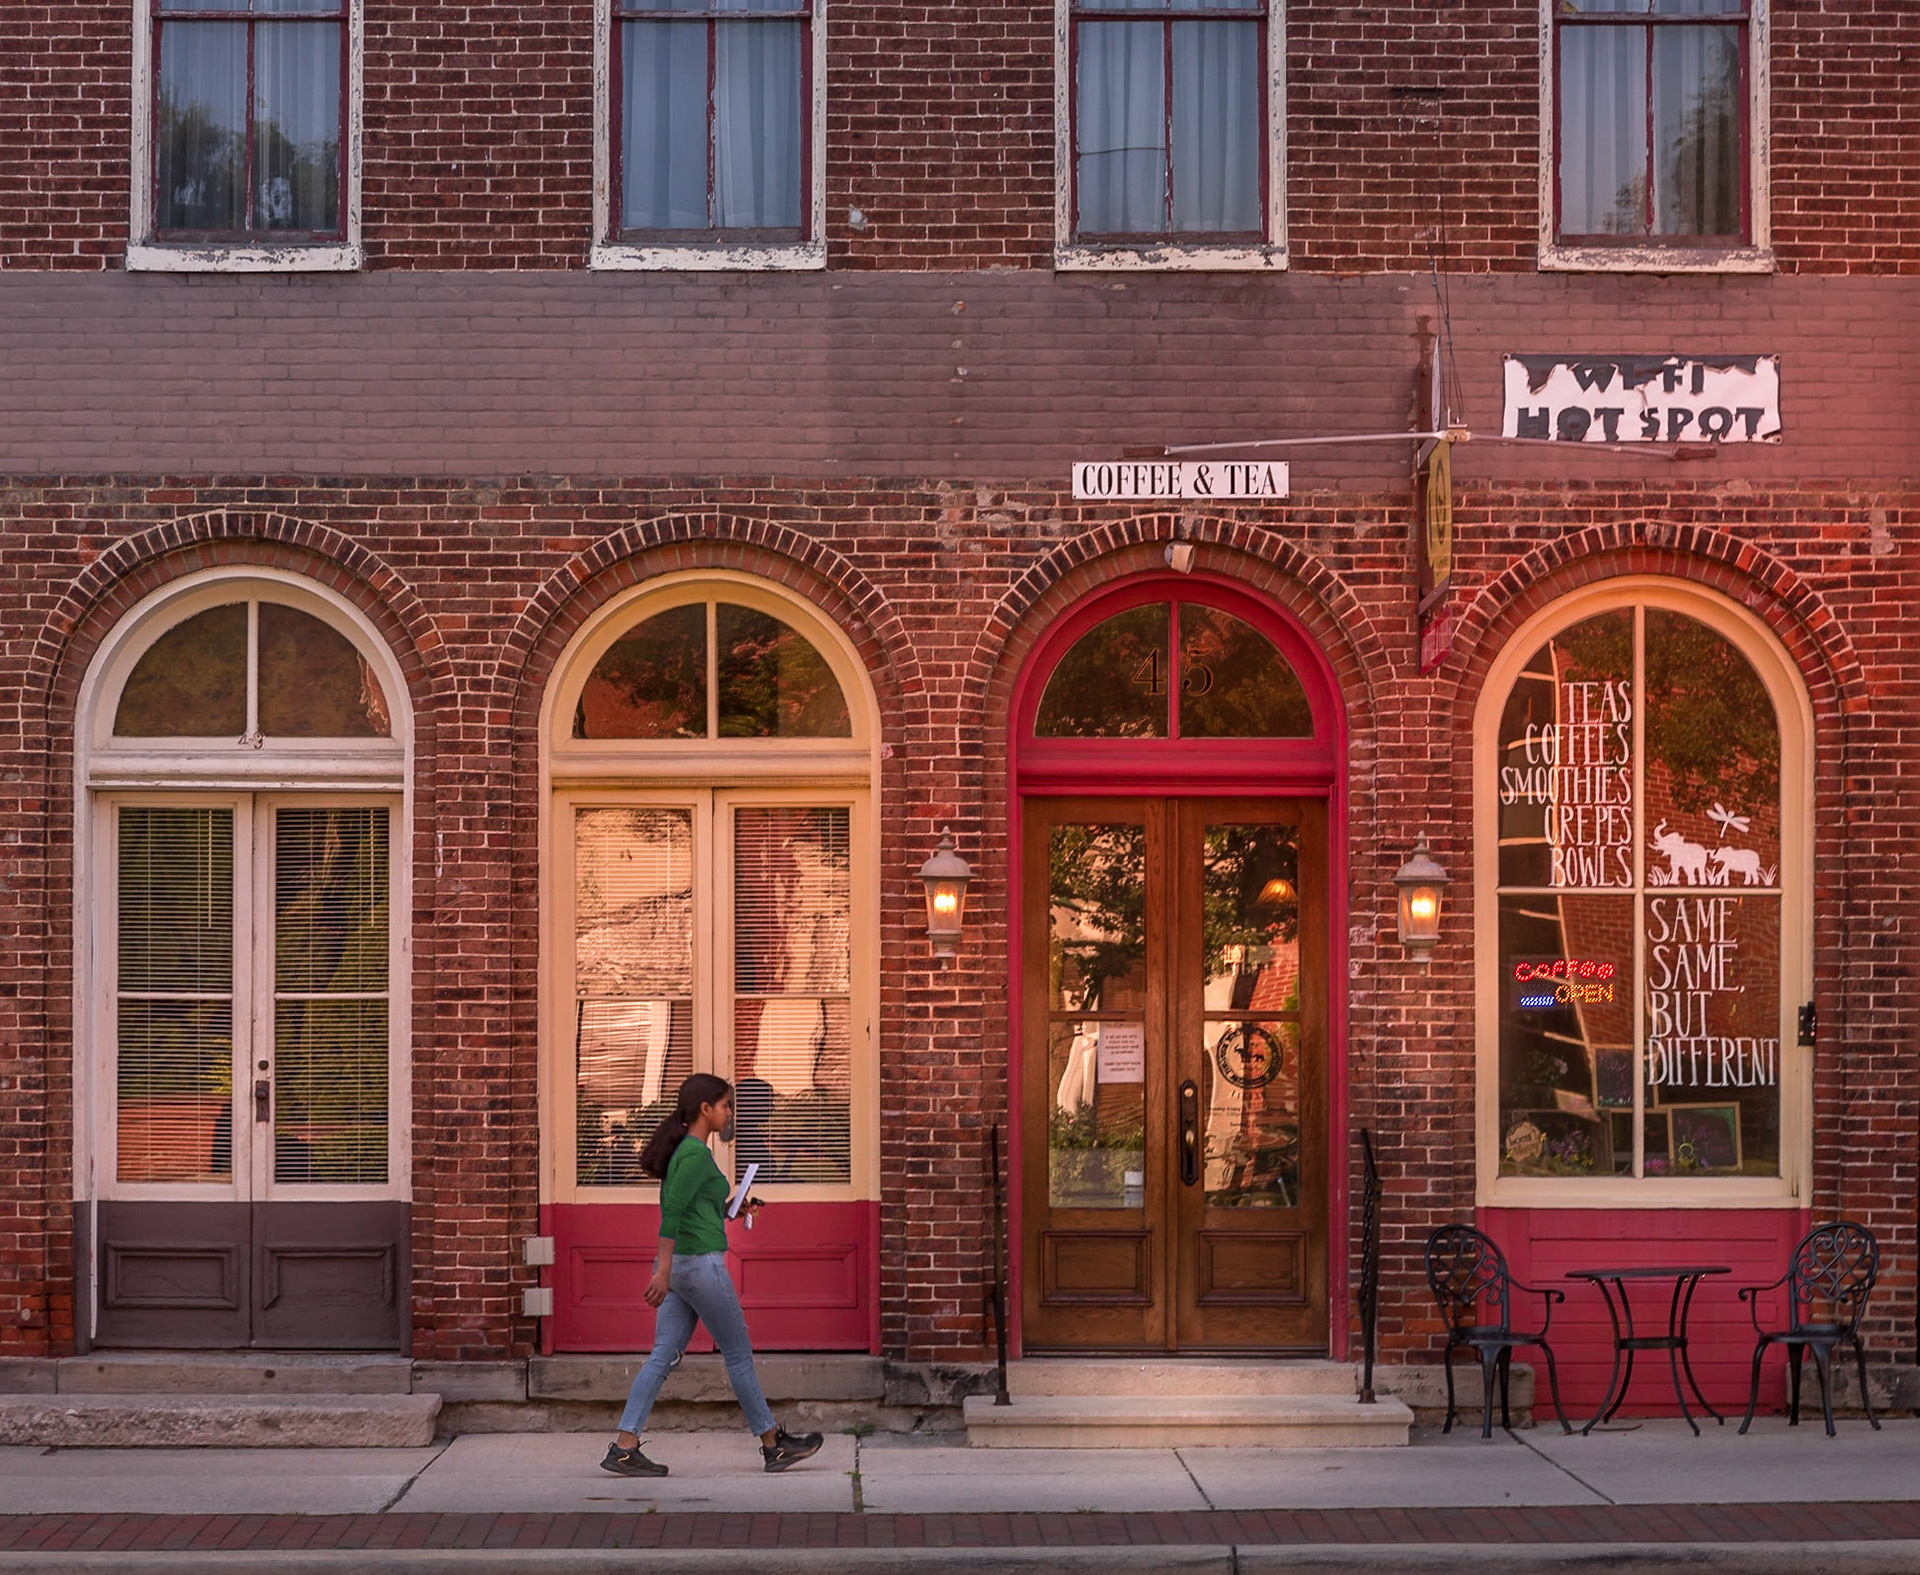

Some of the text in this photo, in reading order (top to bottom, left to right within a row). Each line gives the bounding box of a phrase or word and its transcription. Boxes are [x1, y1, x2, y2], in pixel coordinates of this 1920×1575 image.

[1517, 406, 1765, 442] HOT SPOT
[1081, 463, 1278, 496] COFFEE & TEA
[1132, 645, 1214, 697] 45
[1561, 680, 1632, 724] TEAS
[1525, 723, 1631, 765] COFFEES
[1500, 766, 1632, 805] SMOOTHIES
[1544, 804, 1632, 846] CREPES
[1548, 846, 1632, 887] BOWLS
[1648, 897, 1738, 944] SAME
[1648, 943, 1746, 993] SAME,
[1555, 984, 1614, 1004] OPEN
[1649, 991, 1713, 1039] BUT
[1647, 1037, 1779, 1088] DIFFERENT
